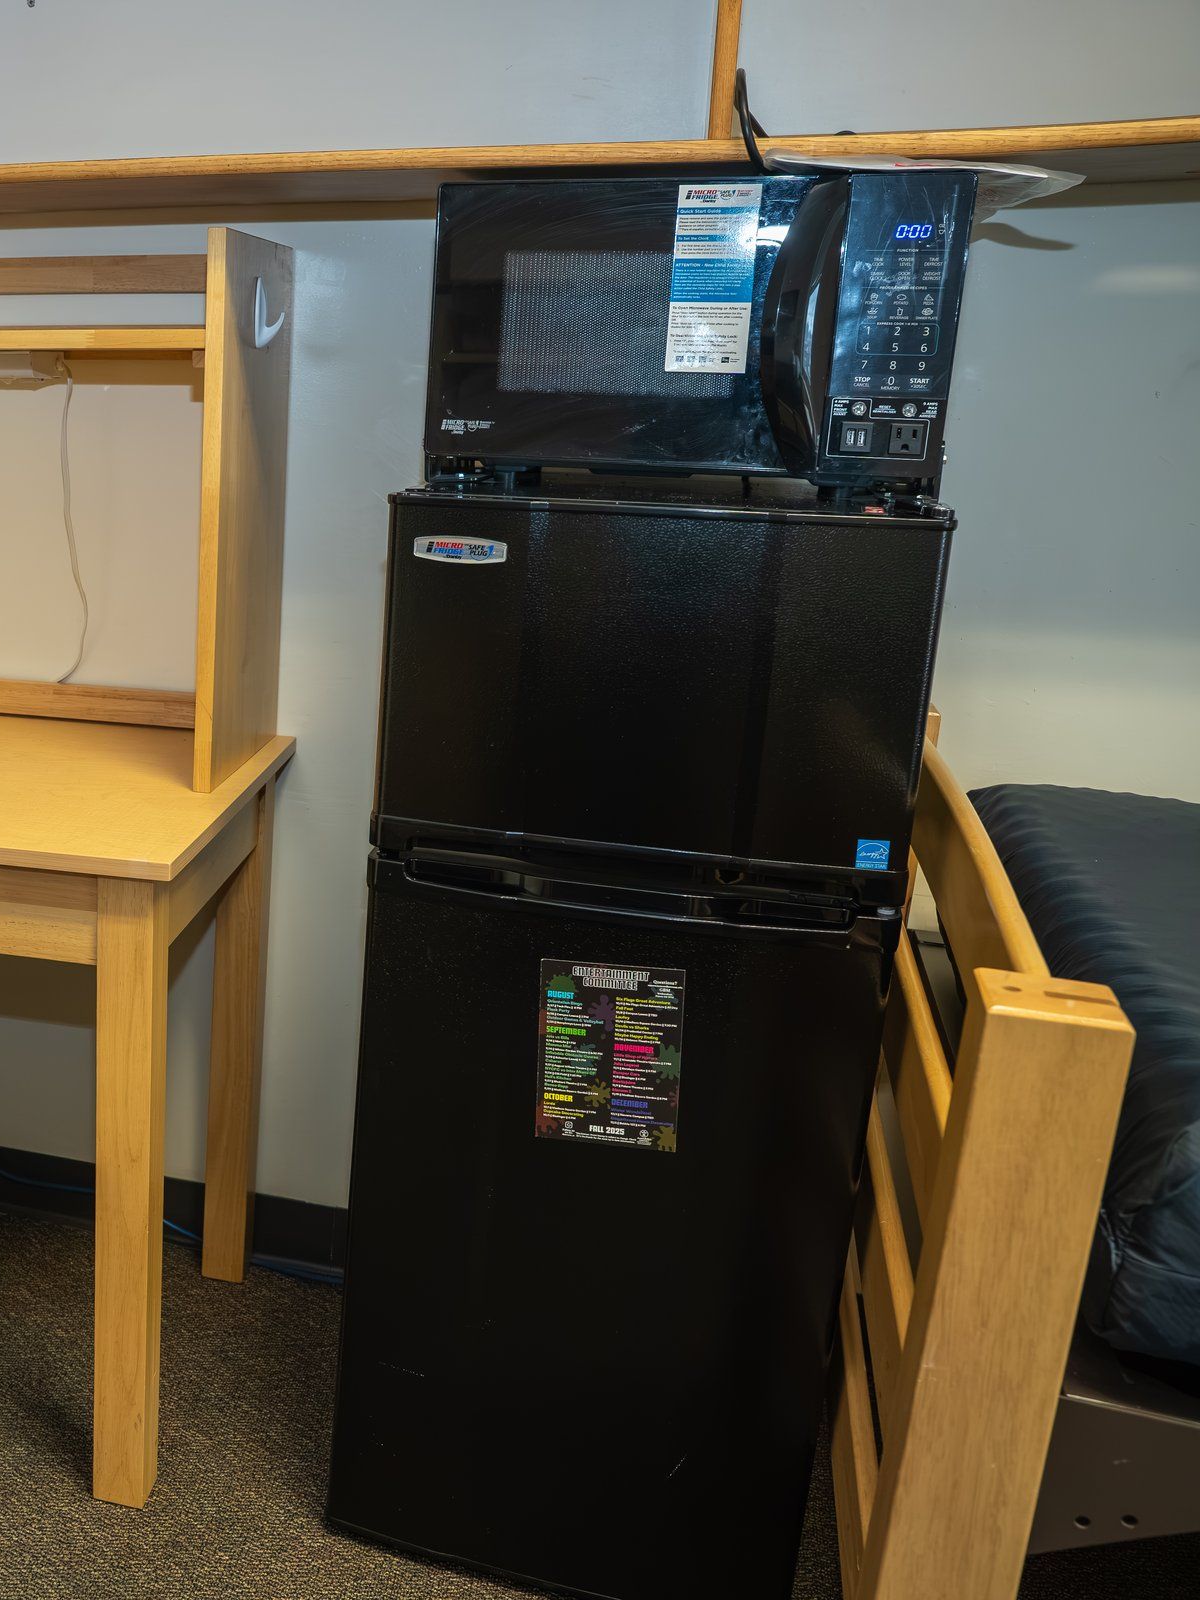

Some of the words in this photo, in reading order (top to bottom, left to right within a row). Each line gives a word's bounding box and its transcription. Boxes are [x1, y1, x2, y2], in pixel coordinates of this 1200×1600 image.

[896, 224, 932, 238] 0:00
[894, 326, 901, 336] 2
[923, 326, 930, 336] 3
[862, 342, 870, 351] 4
[892, 343, 899, 352] 5
[920, 343, 928, 353] 6
[861, 361, 868, 370] 7
[889, 361, 897, 370] 8
[918, 361, 926, 371] 9
[887, 376, 895, 385] 0
[572, 965, 650, 982] ENTERTAINMENT
[582, 976, 638, 991] COMMITTEE
[547, 990, 575, 999] AUGUST
[546, 1025, 587, 1036] SEPTEMBER
[613, 1043, 654, 1054] NOVEMBER
[543, 1092, 573, 1102] OCTOBER
[611, 1098, 648, 1108] DECEMBER
[589, 1124, 604, 1133] FALL
[605, 1127, 625, 1136] 2025
